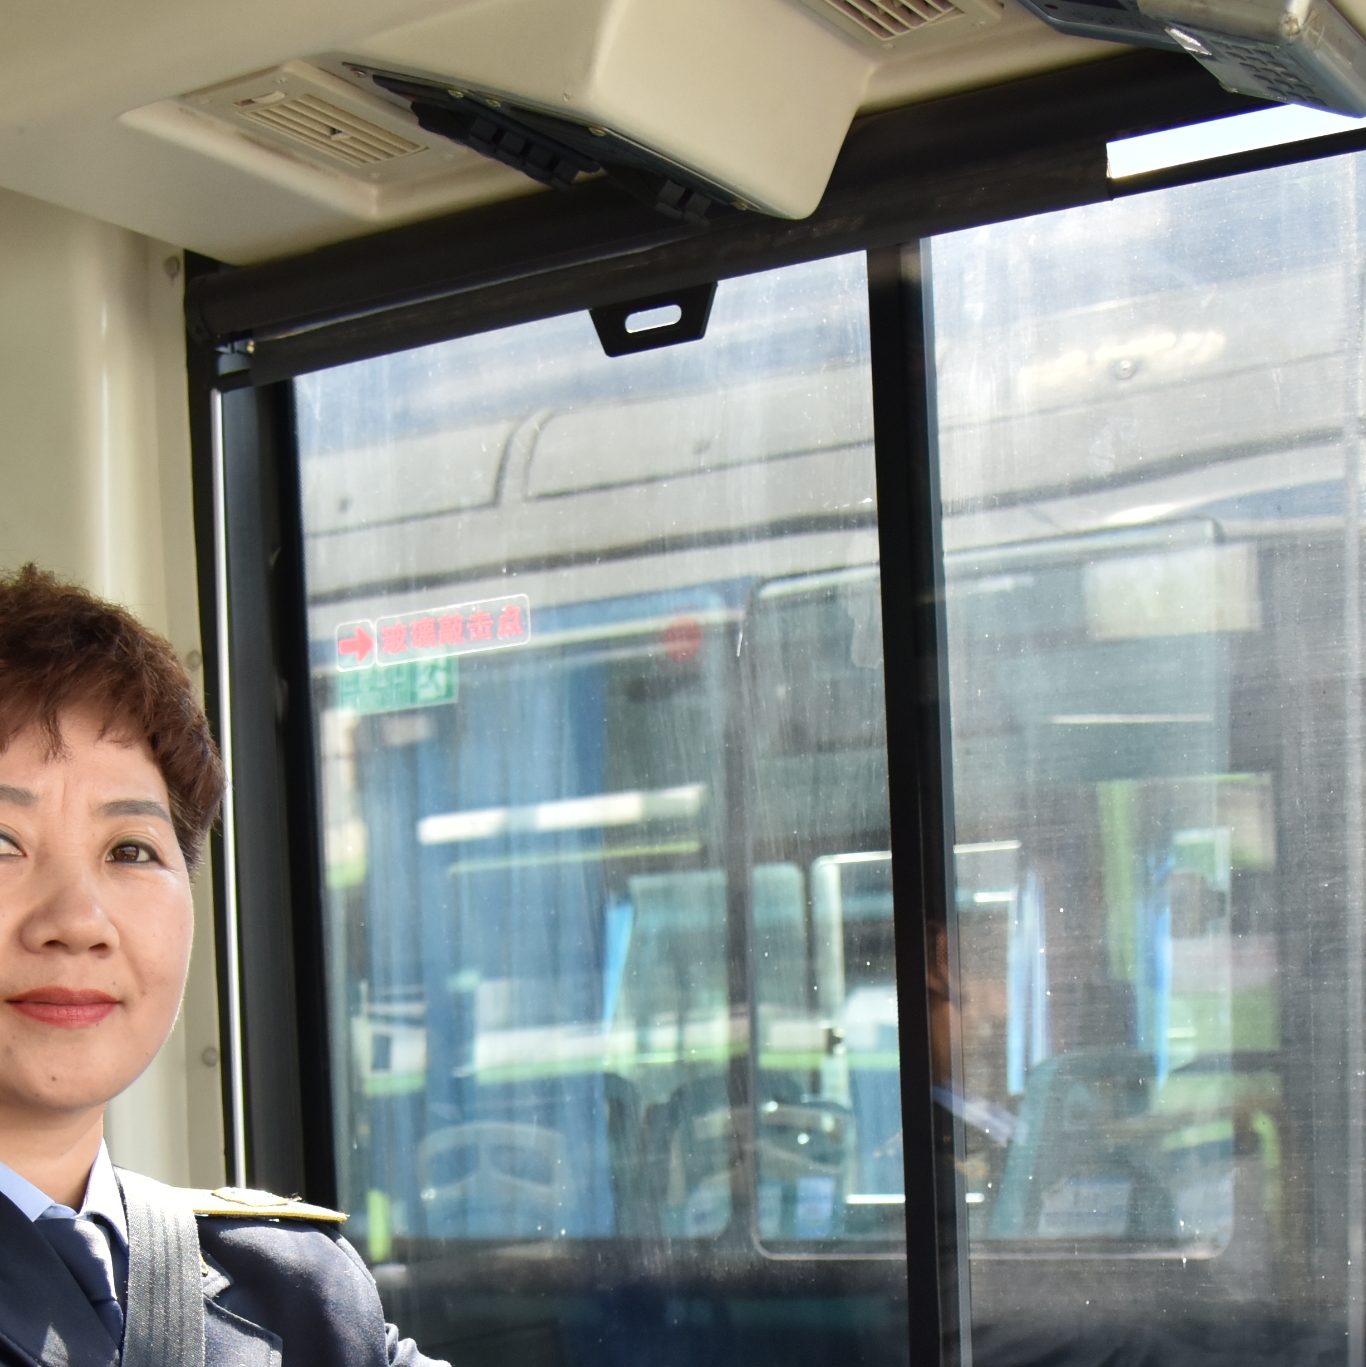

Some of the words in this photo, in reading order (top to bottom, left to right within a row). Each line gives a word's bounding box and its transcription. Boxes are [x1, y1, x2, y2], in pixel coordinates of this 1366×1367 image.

[380, 603, 525, 655] 玻璃敲击点
